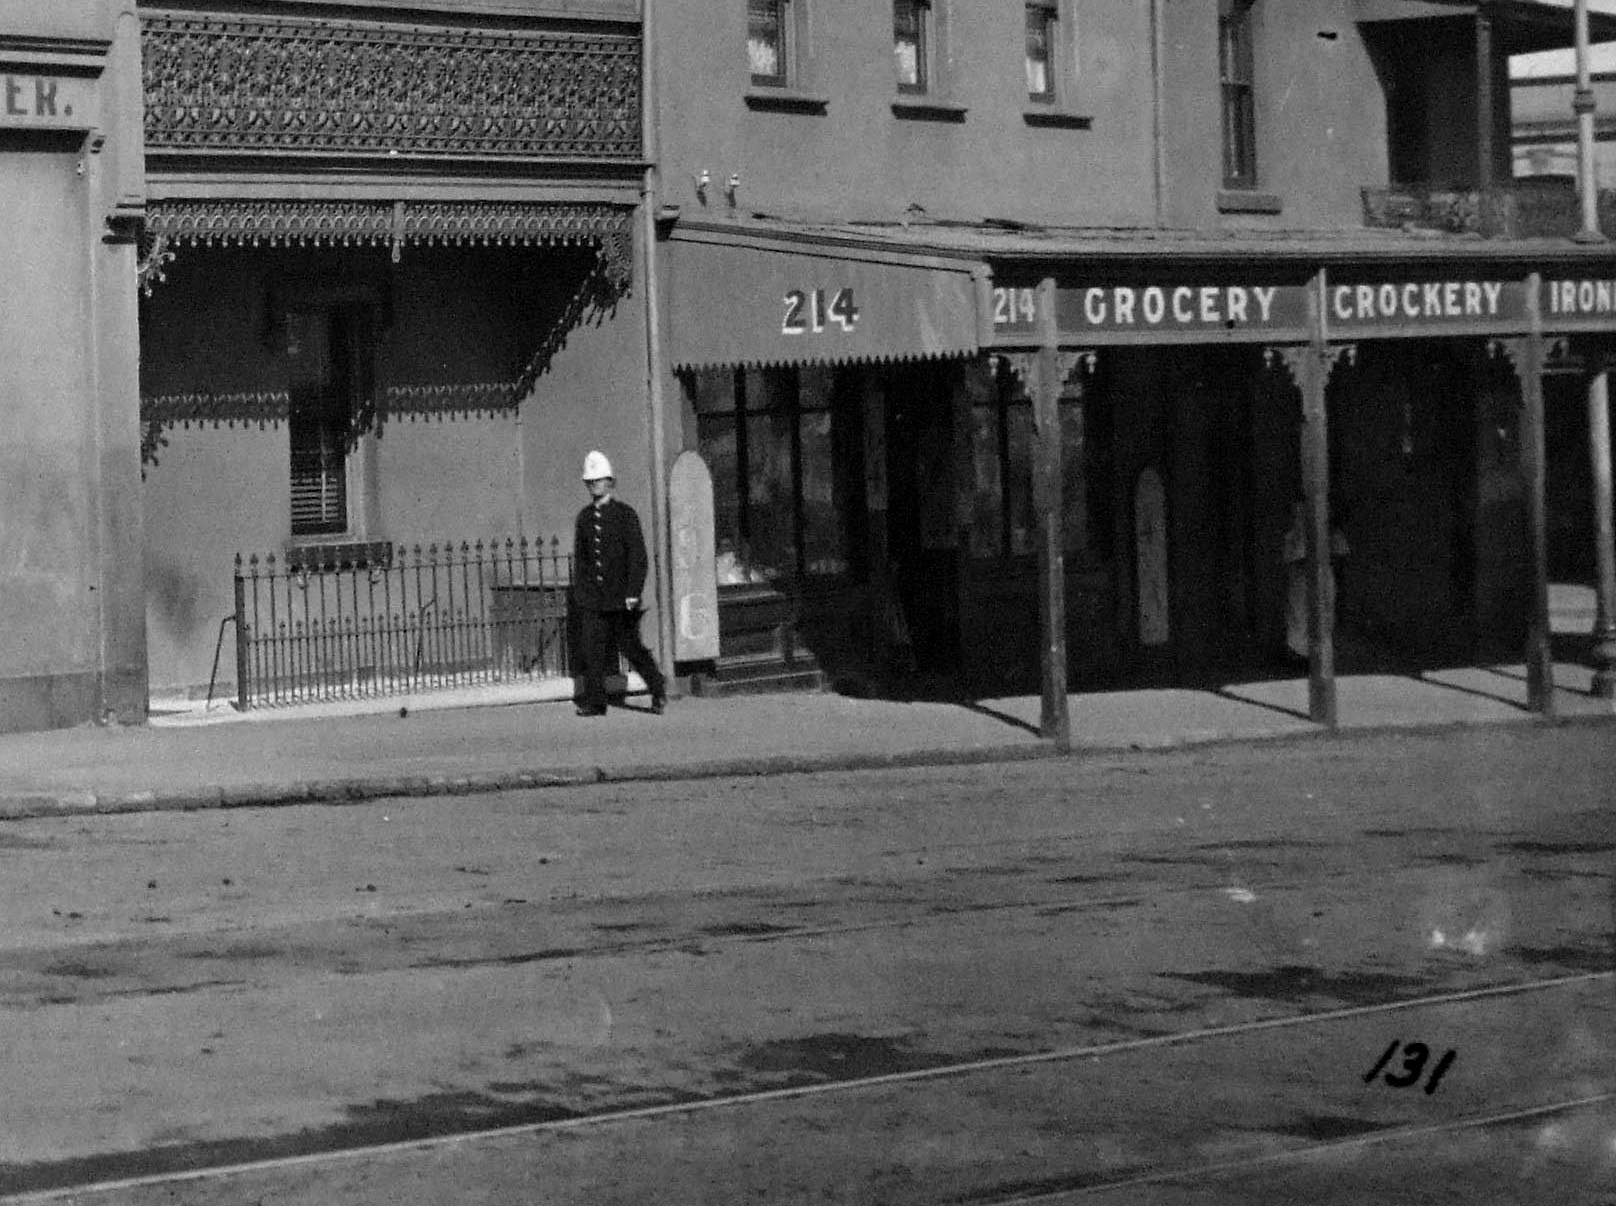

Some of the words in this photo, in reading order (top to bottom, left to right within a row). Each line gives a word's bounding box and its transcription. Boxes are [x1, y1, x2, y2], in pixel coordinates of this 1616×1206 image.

[782, 287, 861, 334] 214
[993, 287, 1036, 325] 214
[1085, 286, 1277, 325] GROCERY
[1334, 282, 1503, 320] CROCKERY
[1550, 279, 1616, 314] IRON
